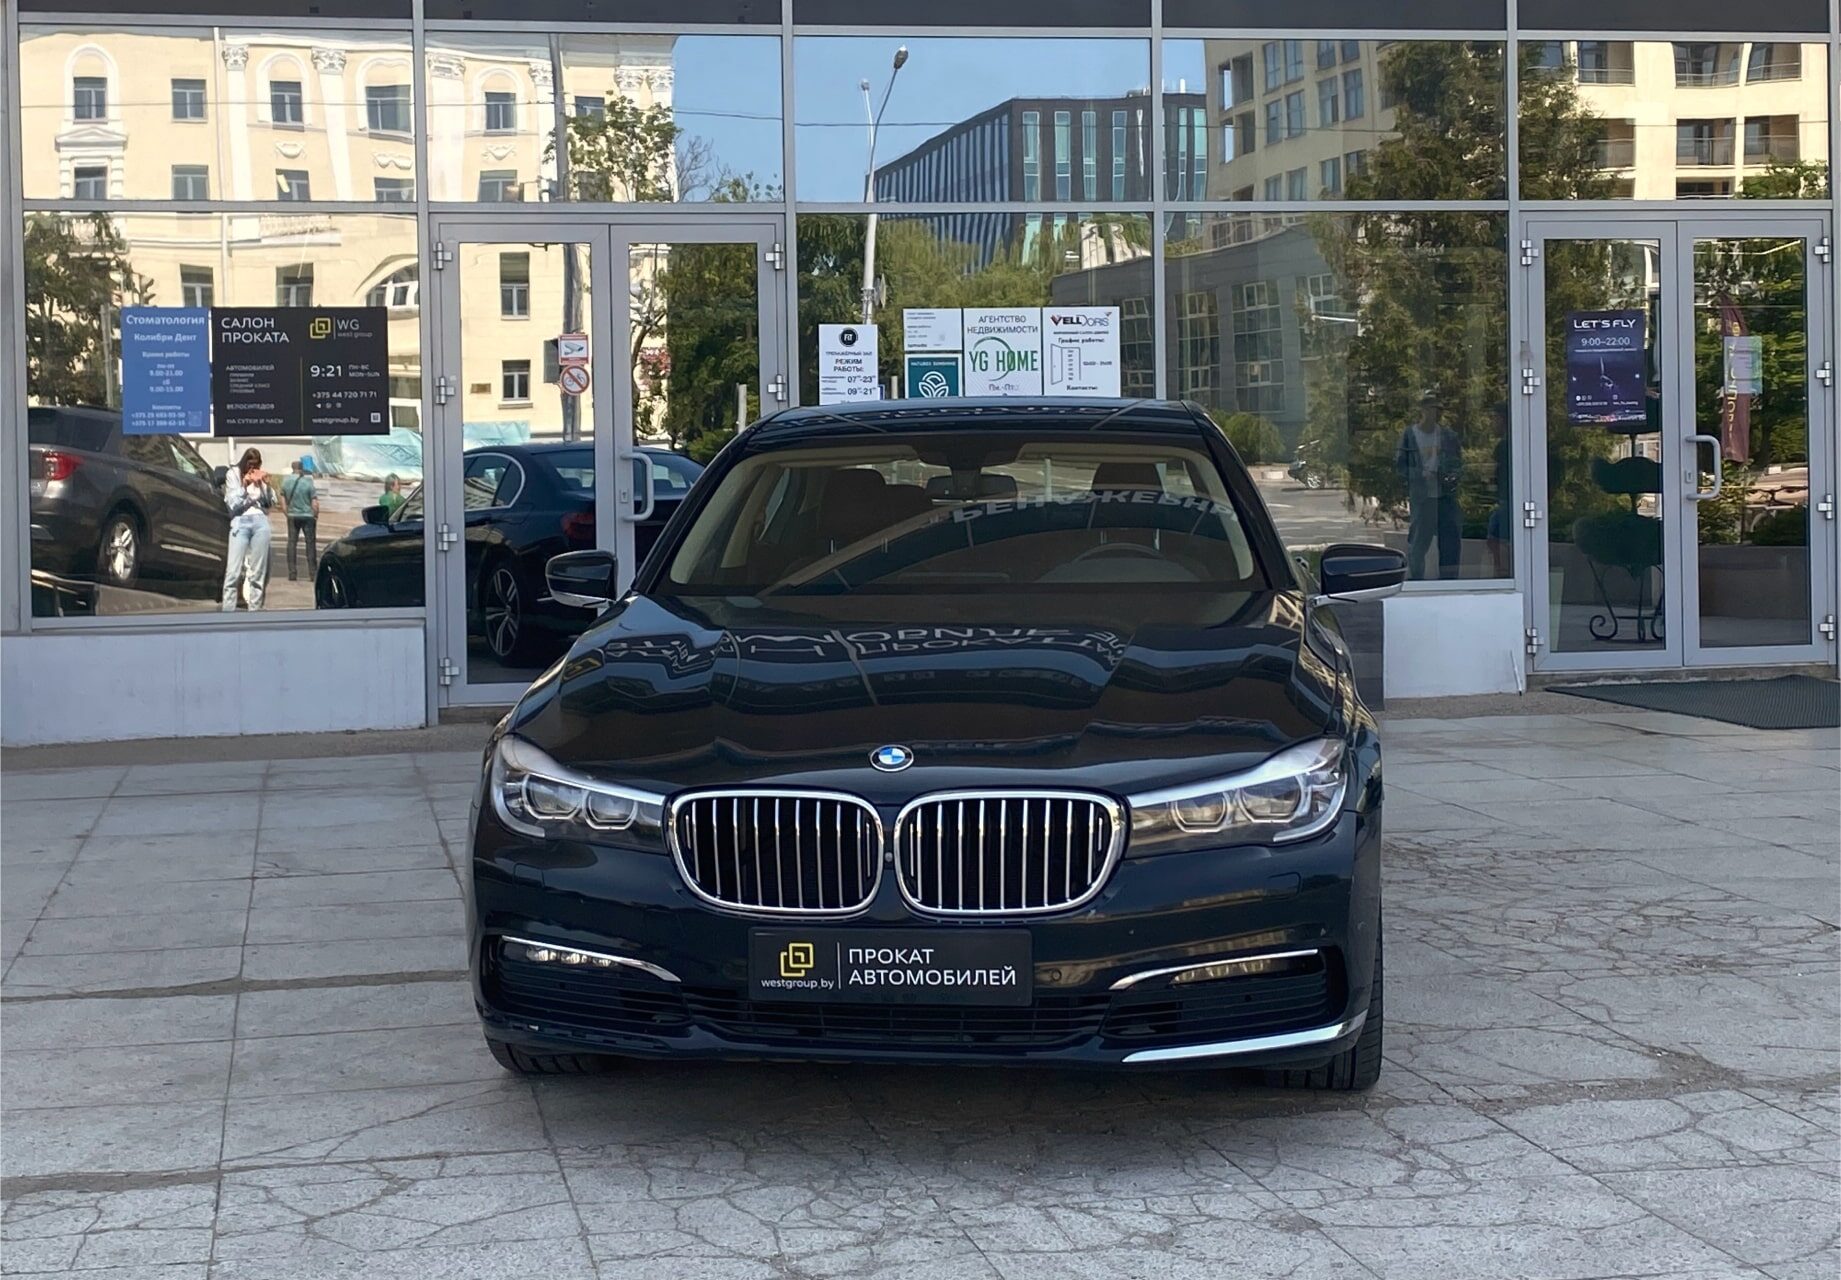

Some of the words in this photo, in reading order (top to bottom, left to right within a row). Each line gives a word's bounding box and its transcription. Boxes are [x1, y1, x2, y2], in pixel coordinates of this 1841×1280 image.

[126, 315, 205, 325] Стоматология
[221, 317, 275, 328] САЛОН
[337, 319, 360, 330] WG
[978, 315, 1026, 323] АГЕНТСТВО
[1573, 319, 1611, 329] LET'S
[1612, 319, 1636, 329] FLY
[967, 325, 1039, 335] НЕДВИЖИМОСТИ
[134, 333, 173, 343] Колибри
[174, 333, 197, 343] Дент
[222, 332, 290, 343] ПРОКАТА
[969, 350, 989, 372] YG
[996, 350, 1039, 372] HOME
[310, 365, 342, 377] 9:21
[849, 948, 935, 965] ПРОКАТ
[848, 965, 1017, 986] АВТОМОБИЛЕЙ
[760, 978, 834, 990] westgroup.by
